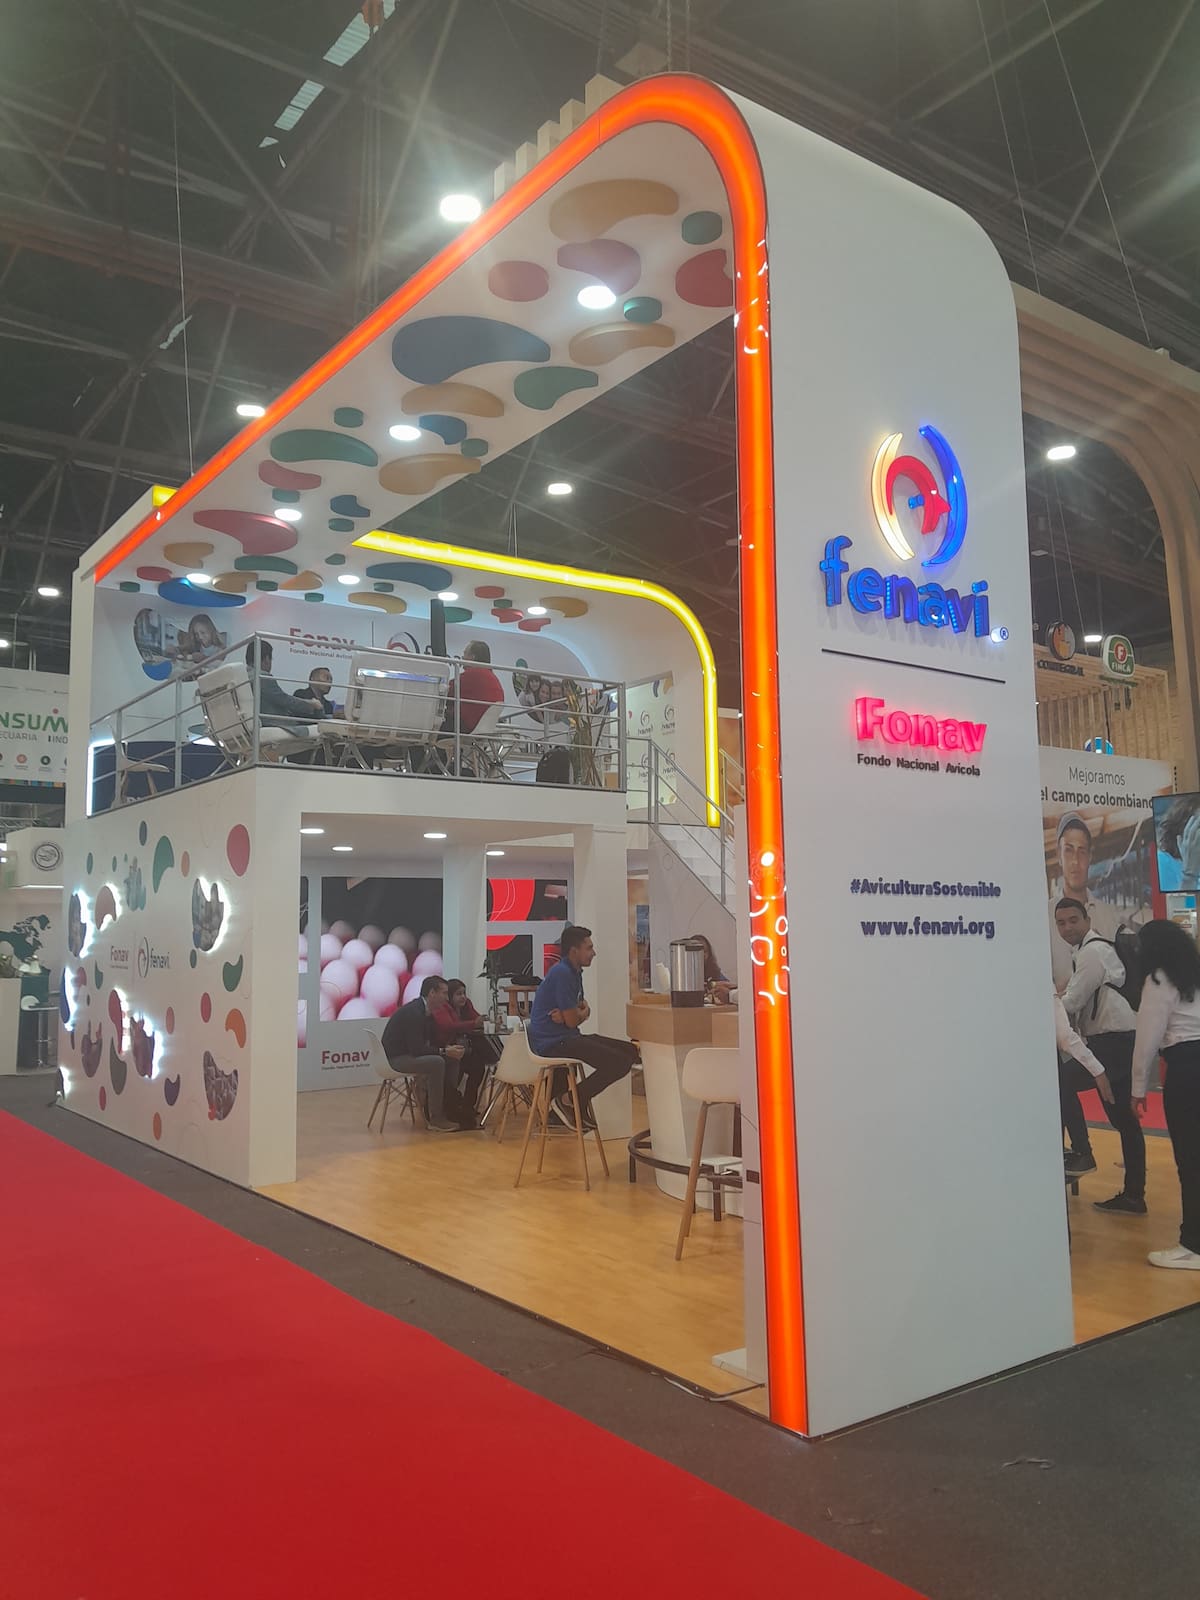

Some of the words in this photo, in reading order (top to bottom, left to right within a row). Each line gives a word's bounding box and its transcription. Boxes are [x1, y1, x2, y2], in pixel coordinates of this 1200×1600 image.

[819, 535, 990, 638] fenavi
[1111, 662, 1131, 673] FINCA
[856, 697, 987, 753] Fonav
[857, 753, 891, 767] Fondo
[896, 757, 940, 772] Nacional
[1068, 766, 1126, 786] Mejoramos
[1051, 790, 1090, 807] campo
[850, 877, 1001, 897] #AviculturaSostenible
[860, 915, 995, 939] www.fenavi.org
[321, 1050, 370, 1064] Fonav
